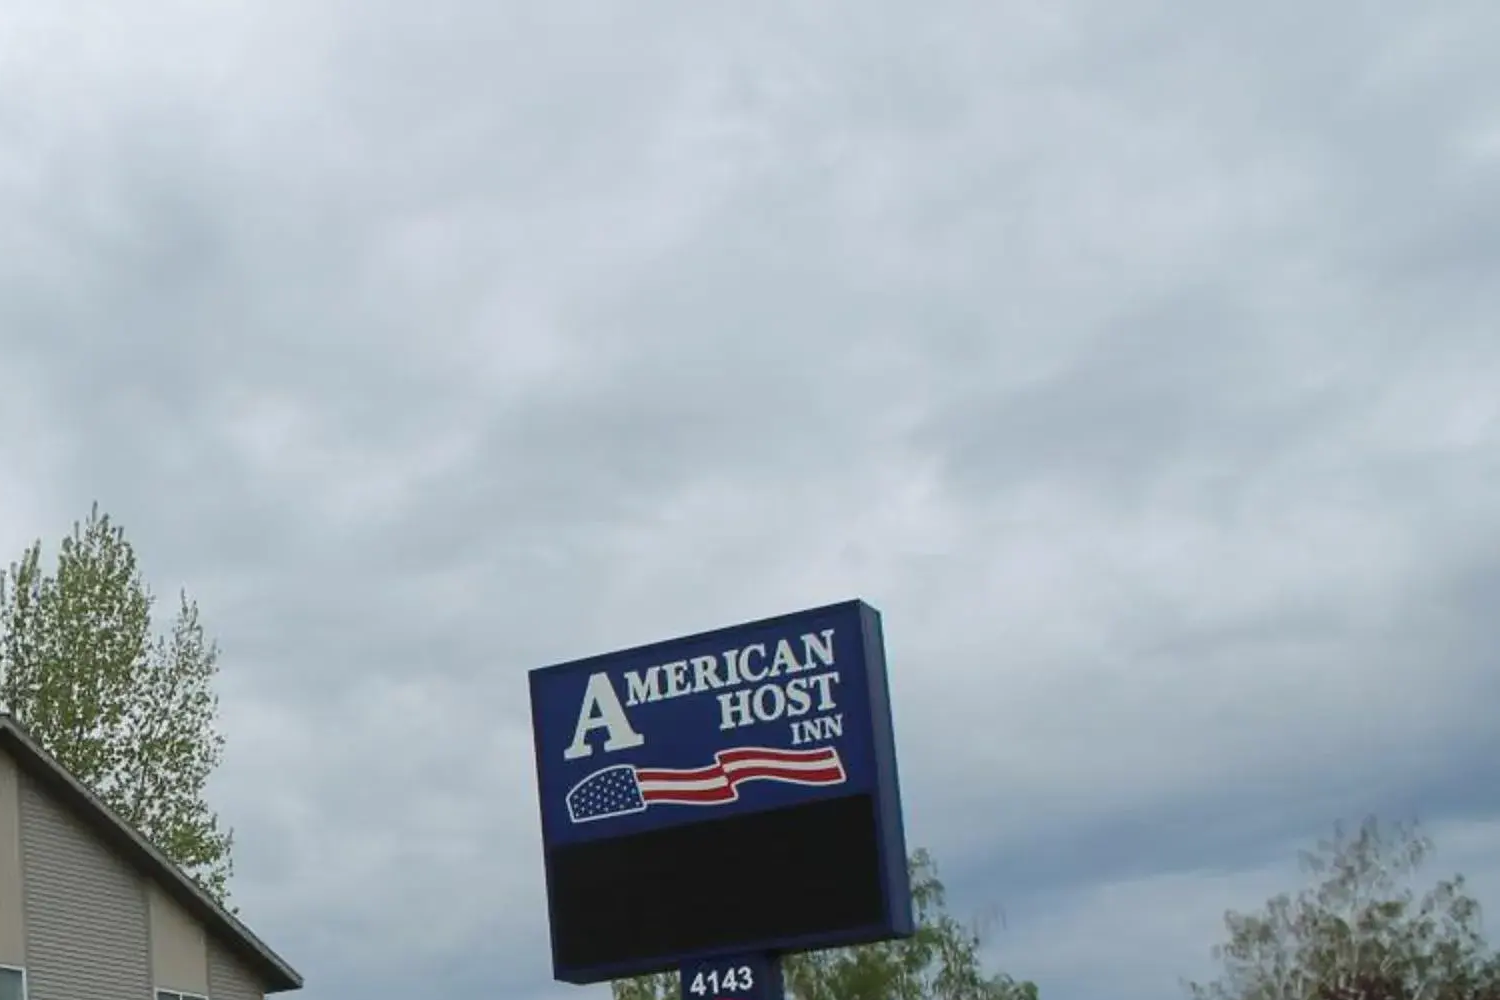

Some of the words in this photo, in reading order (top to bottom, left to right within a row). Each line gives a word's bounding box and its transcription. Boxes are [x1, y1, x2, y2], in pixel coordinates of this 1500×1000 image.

[564, 629, 836, 760] AMERICAN
[716, 672, 840, 730] HOST
[791, 714, 844, 745] INN
[690, 966, 754, 996] 4143
